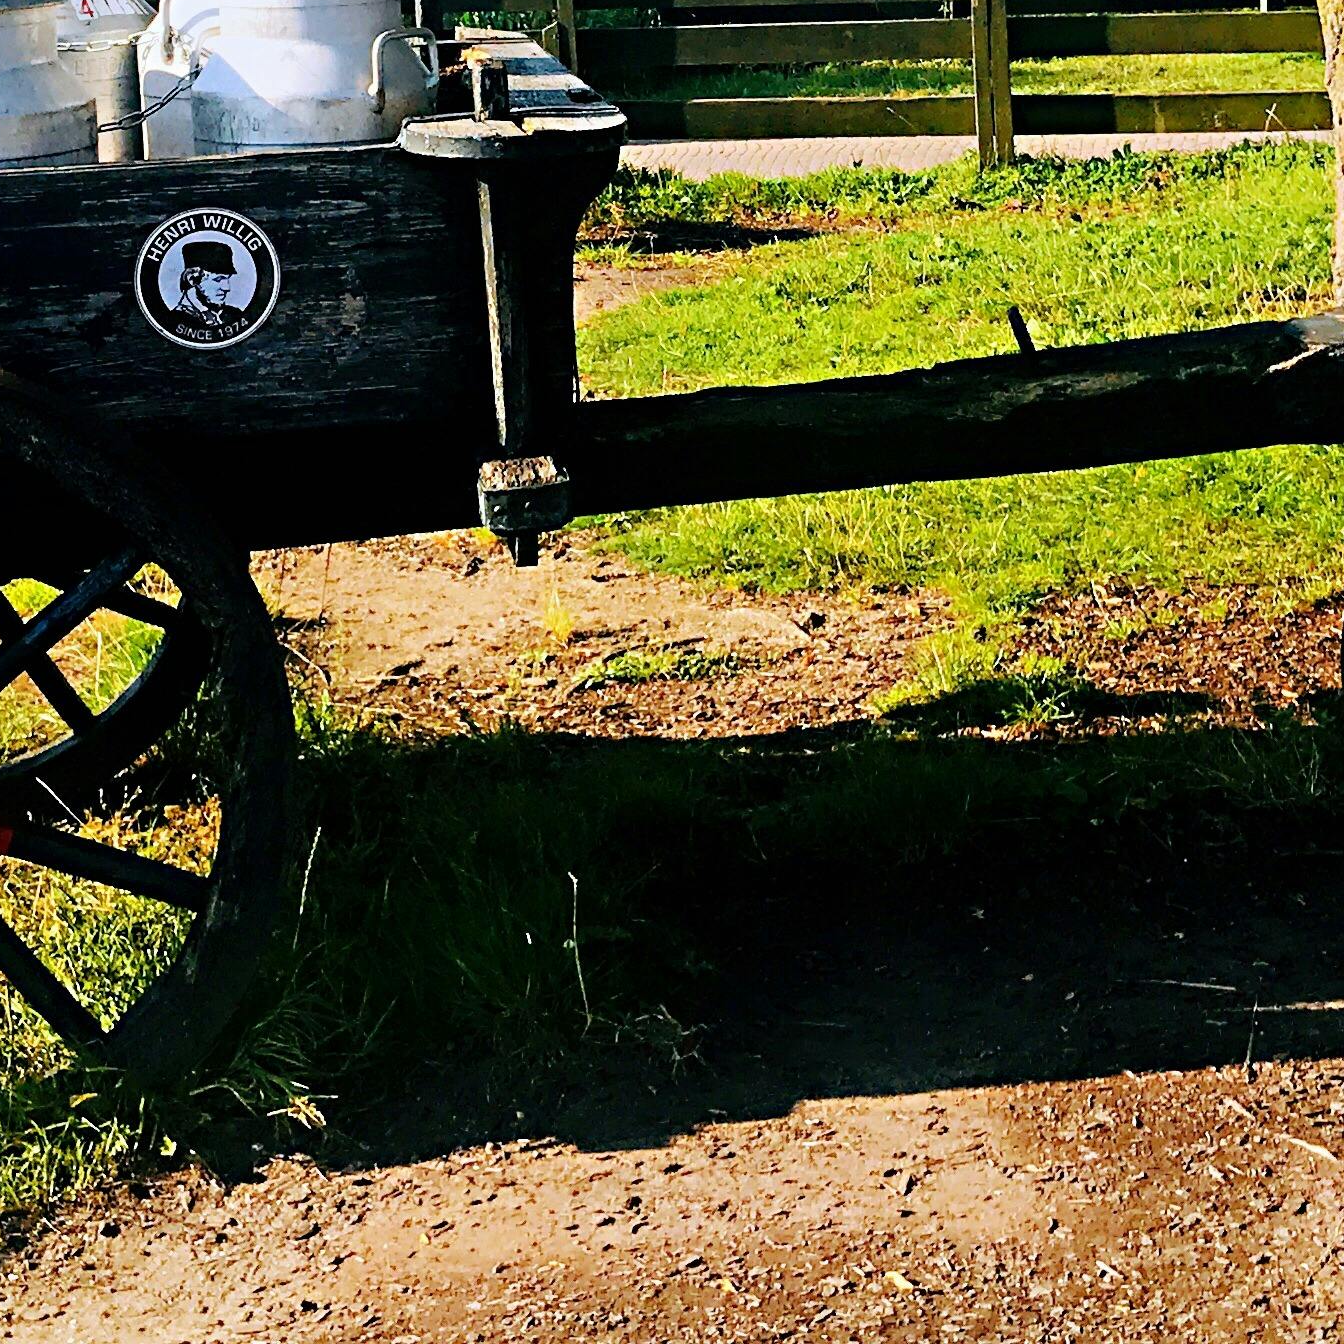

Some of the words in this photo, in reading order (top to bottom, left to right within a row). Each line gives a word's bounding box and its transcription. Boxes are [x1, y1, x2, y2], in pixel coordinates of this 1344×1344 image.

[147, 217, 197, 262] HENRI
[202, 214, 262, 252] WILLIG
[175, 323, 213, 341] SINCE
[218, 317, 249, 338] 1974
